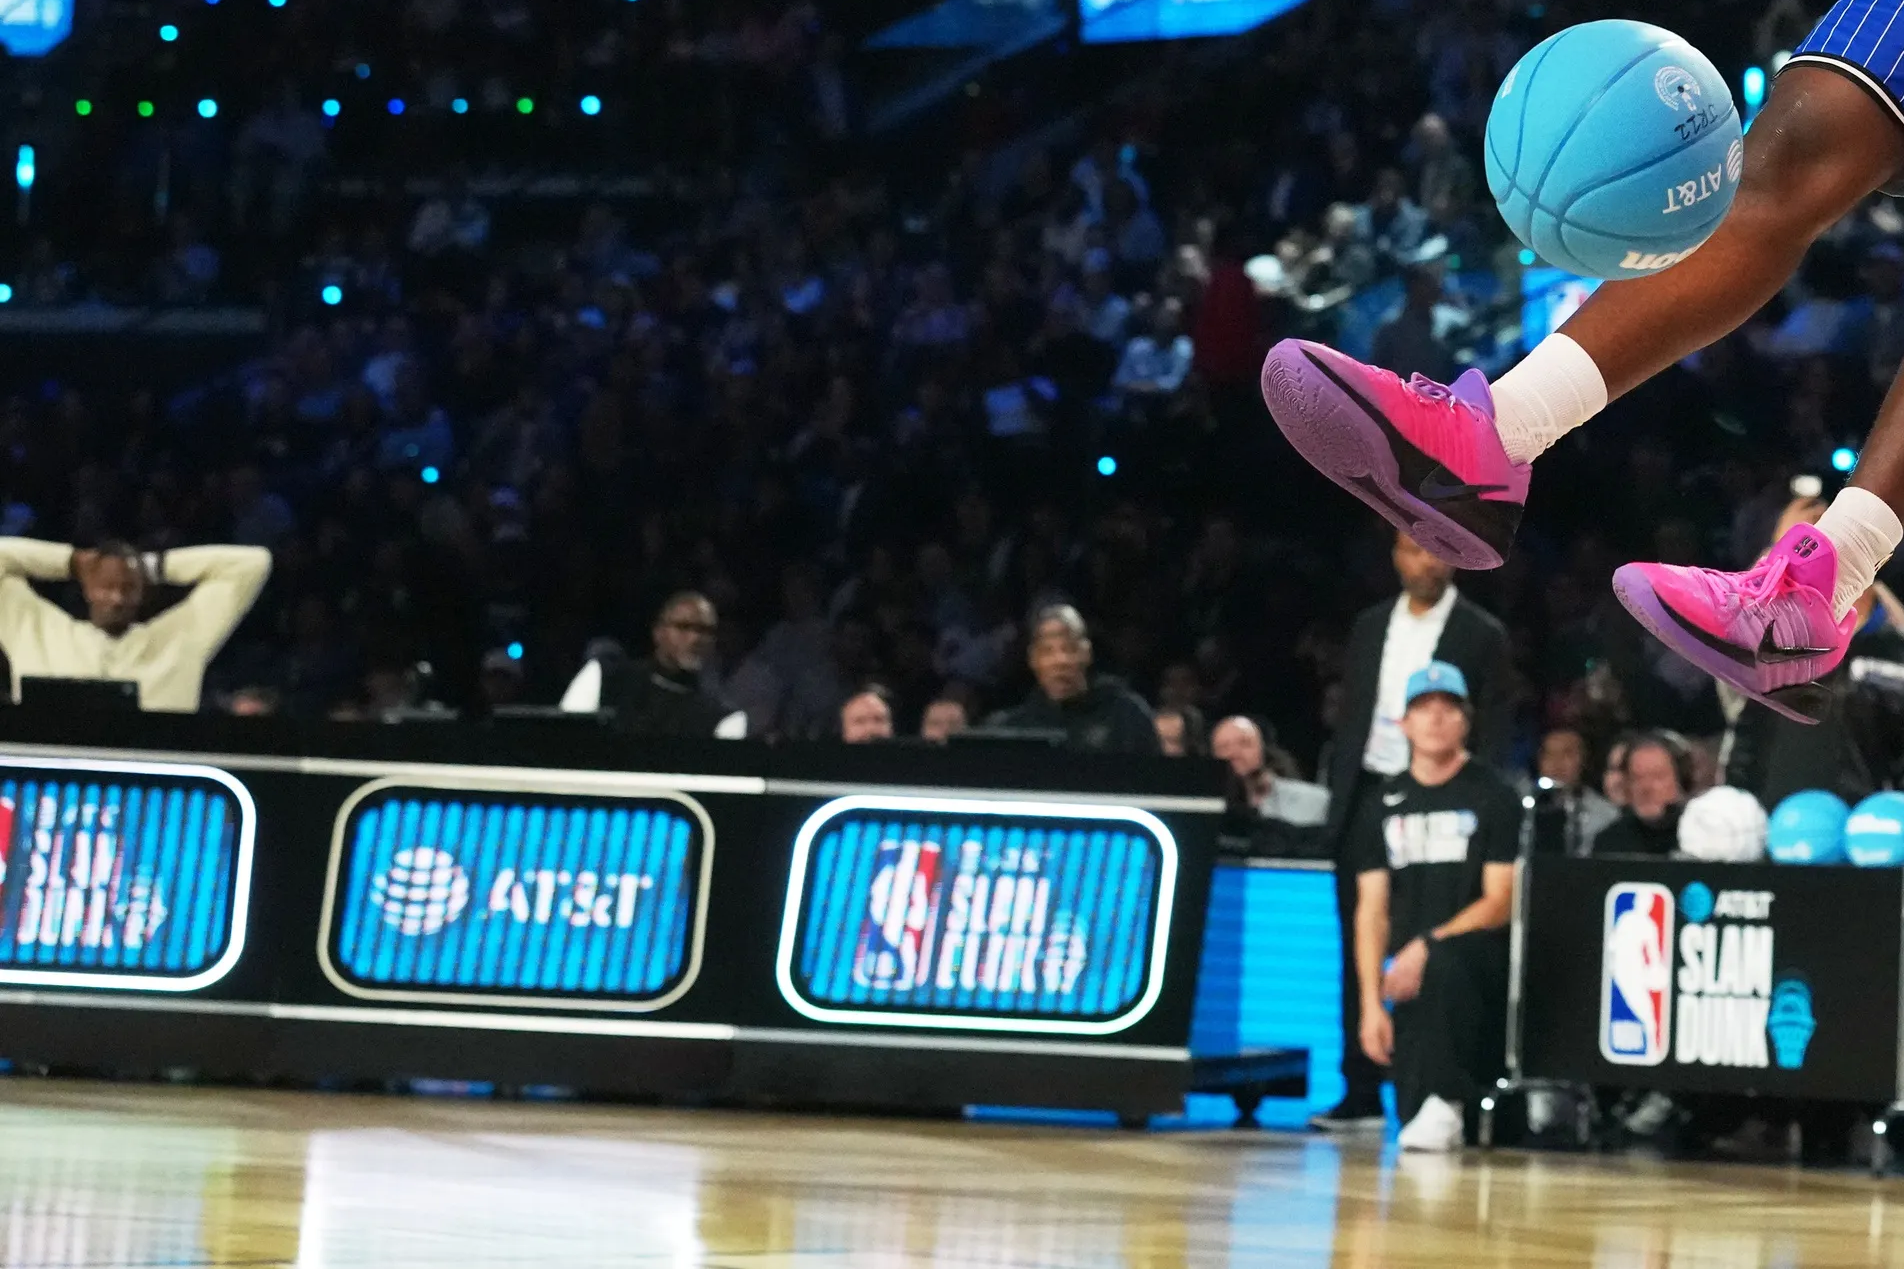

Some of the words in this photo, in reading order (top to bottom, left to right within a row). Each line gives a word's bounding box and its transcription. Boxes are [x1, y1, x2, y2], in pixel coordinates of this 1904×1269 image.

[1662, 163, 1722, 214] AT&T
[488, 867, 654, 929] AT&T
[1677, 923, 1774, 996] SLAM
[1674, 994, 1771, 1068] DUNK
